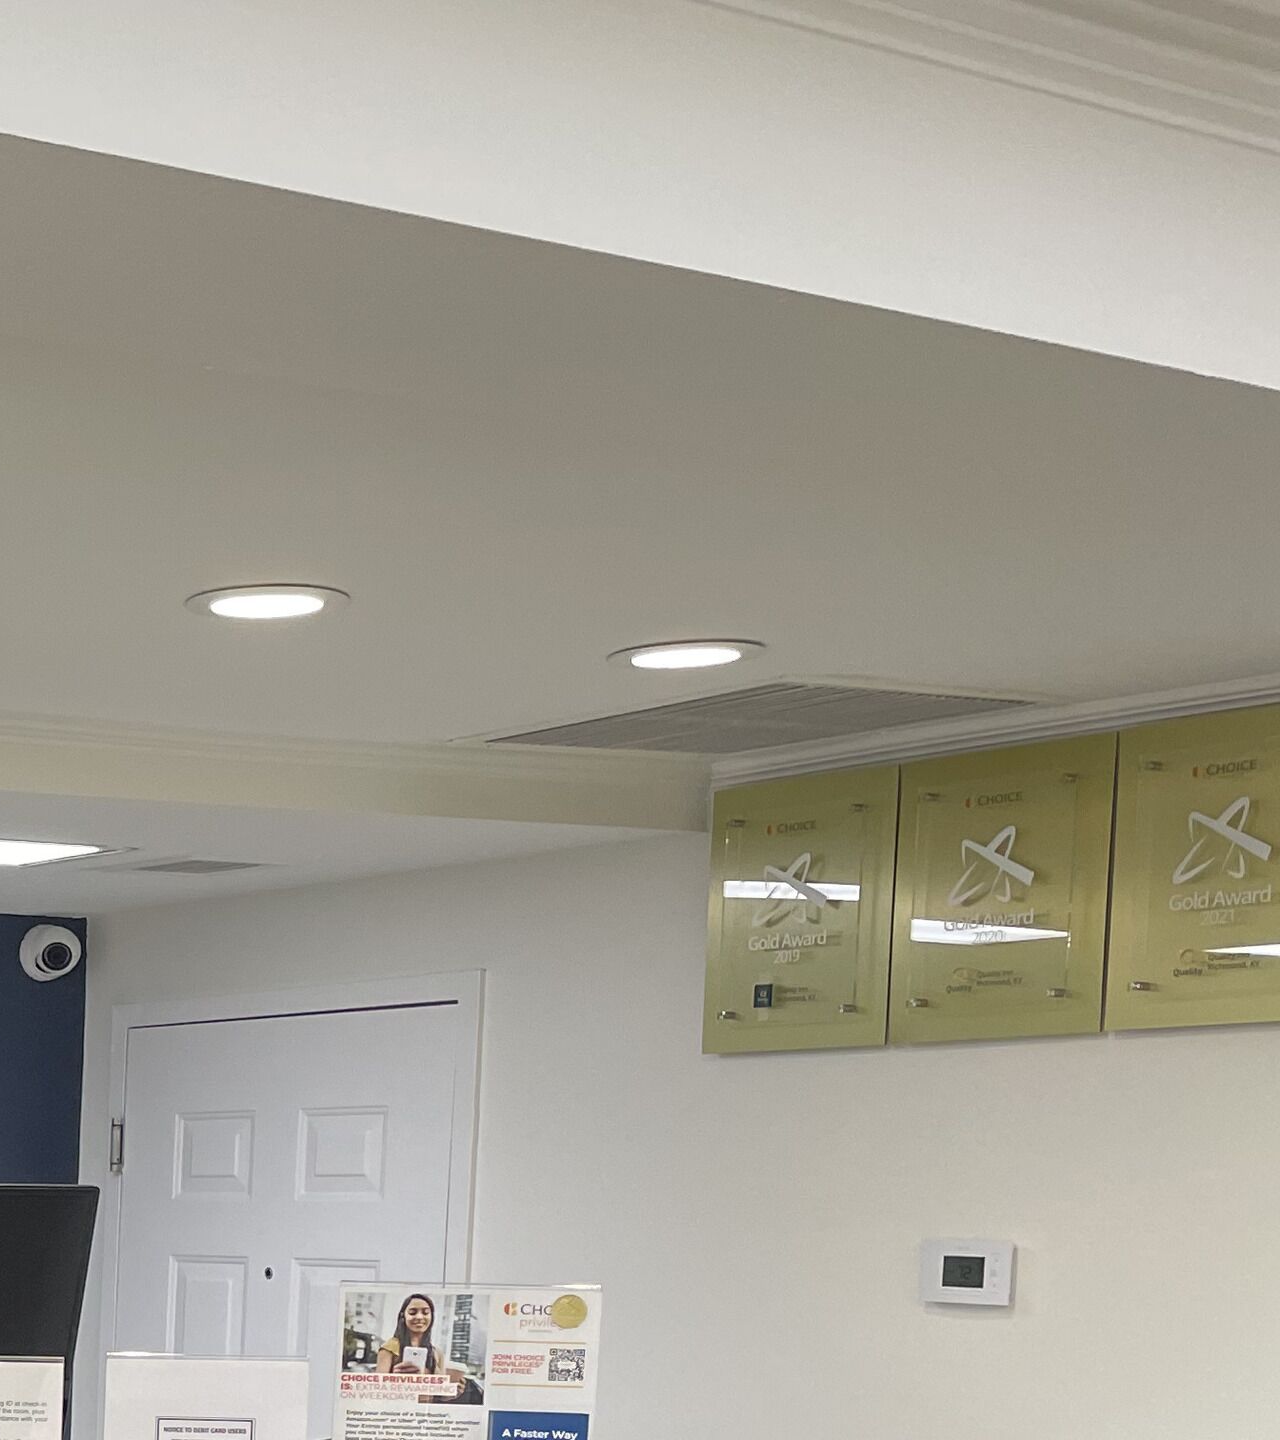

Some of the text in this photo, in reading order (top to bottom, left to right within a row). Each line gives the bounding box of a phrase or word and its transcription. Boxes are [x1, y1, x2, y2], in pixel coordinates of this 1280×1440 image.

[1206, 759, 1257, 776] CHOICE
[978, 791, 1023, 807] CHOICE
[777, 820, 816, 834] CHOICE
[1169, 885, 1272, 911] Gold Award
[944, 908, 1035, 931] Gold Award
[1200, 909, 1235, 925] 2021
[748, 930, 827, 951] Gold Award
[774, 950, 800, 964] 2019
[1173, 967, 1203, 978] Quality
[946, 985, 972, 994] Quality
[341, 1374, 379, 1382] CHOICE
[340, 1382, 455, 1394] IS: EXTRA REWARDING
[340, 1391, 416, 1401] ON WEEKDAYS
[502, 1429, 578, 1440] A Faster Way
